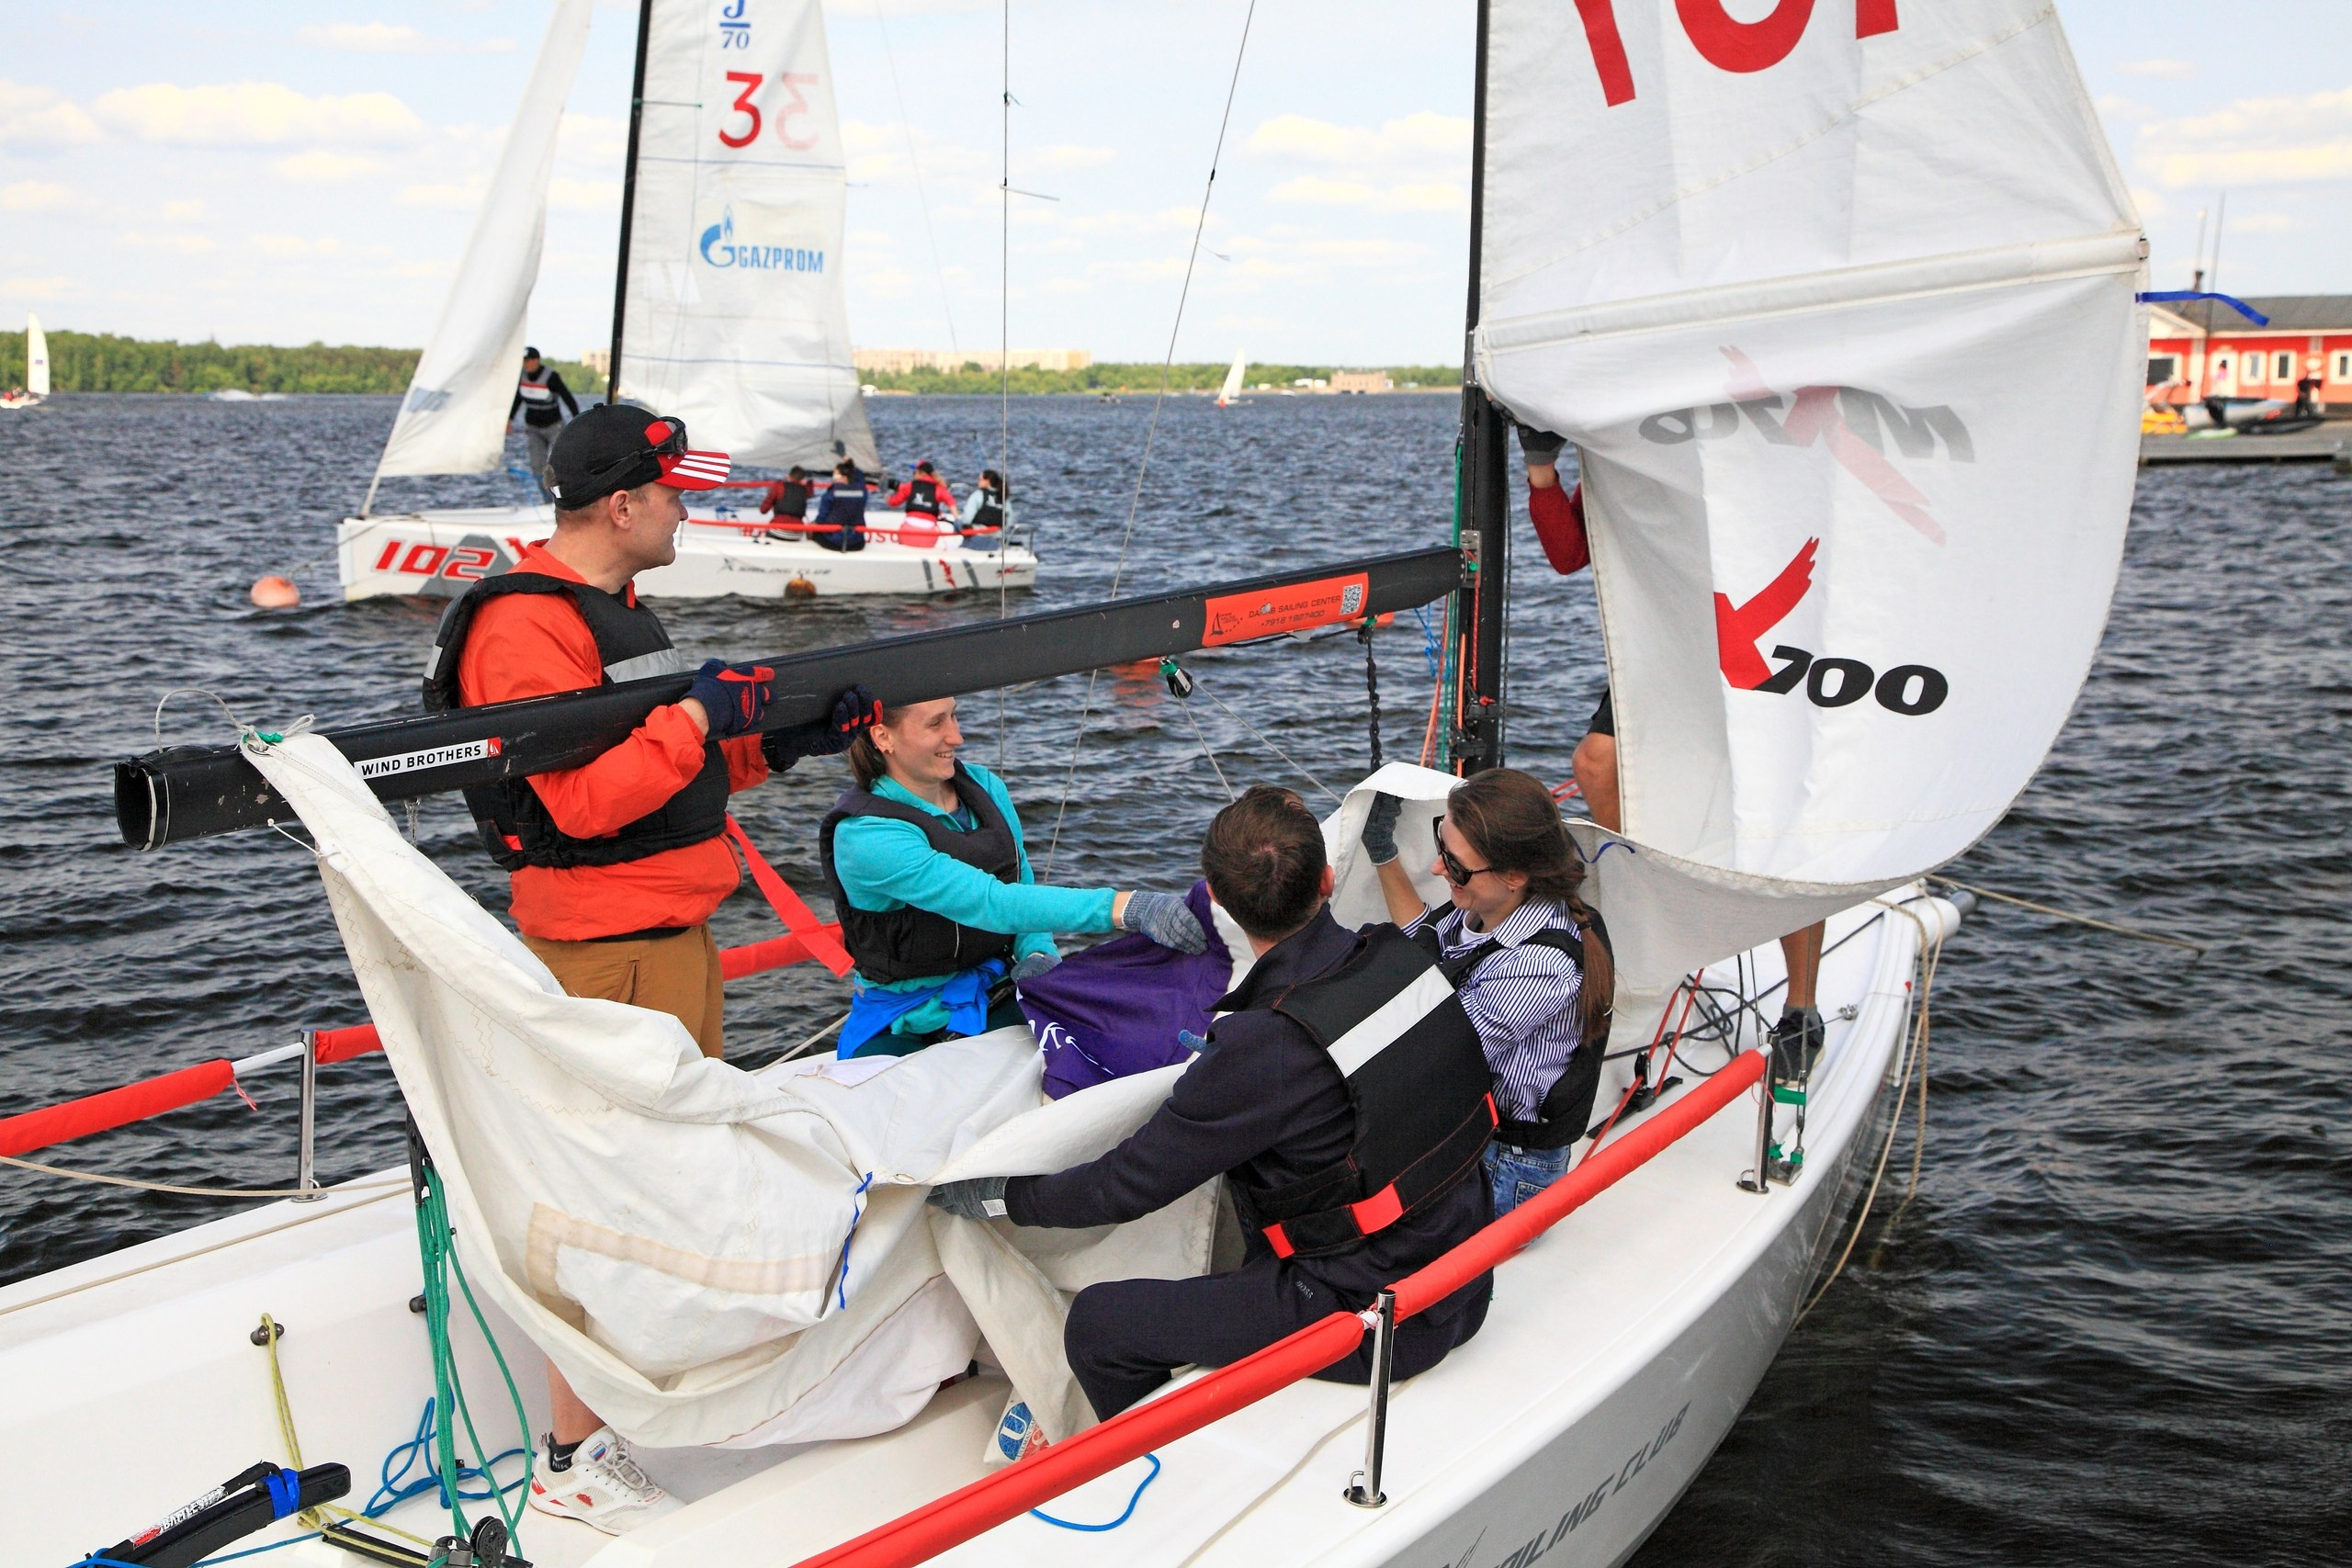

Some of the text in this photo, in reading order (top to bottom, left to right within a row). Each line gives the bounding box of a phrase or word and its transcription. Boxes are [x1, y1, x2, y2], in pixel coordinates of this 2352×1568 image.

[722, 30, 750, 50] 70
[718, 70, 763, 150] 3
[739, 244, 824, 274] GAZPROM
[375, 540, 496, 581] 102
[1278, 602, 1308, 613] SAILING
[1311, 595, 1341, 607] CENTER
[361, 744, 481, 776] WIND BROTHERS
[1494, 1400, 1691, 1568] AILING CLUB
